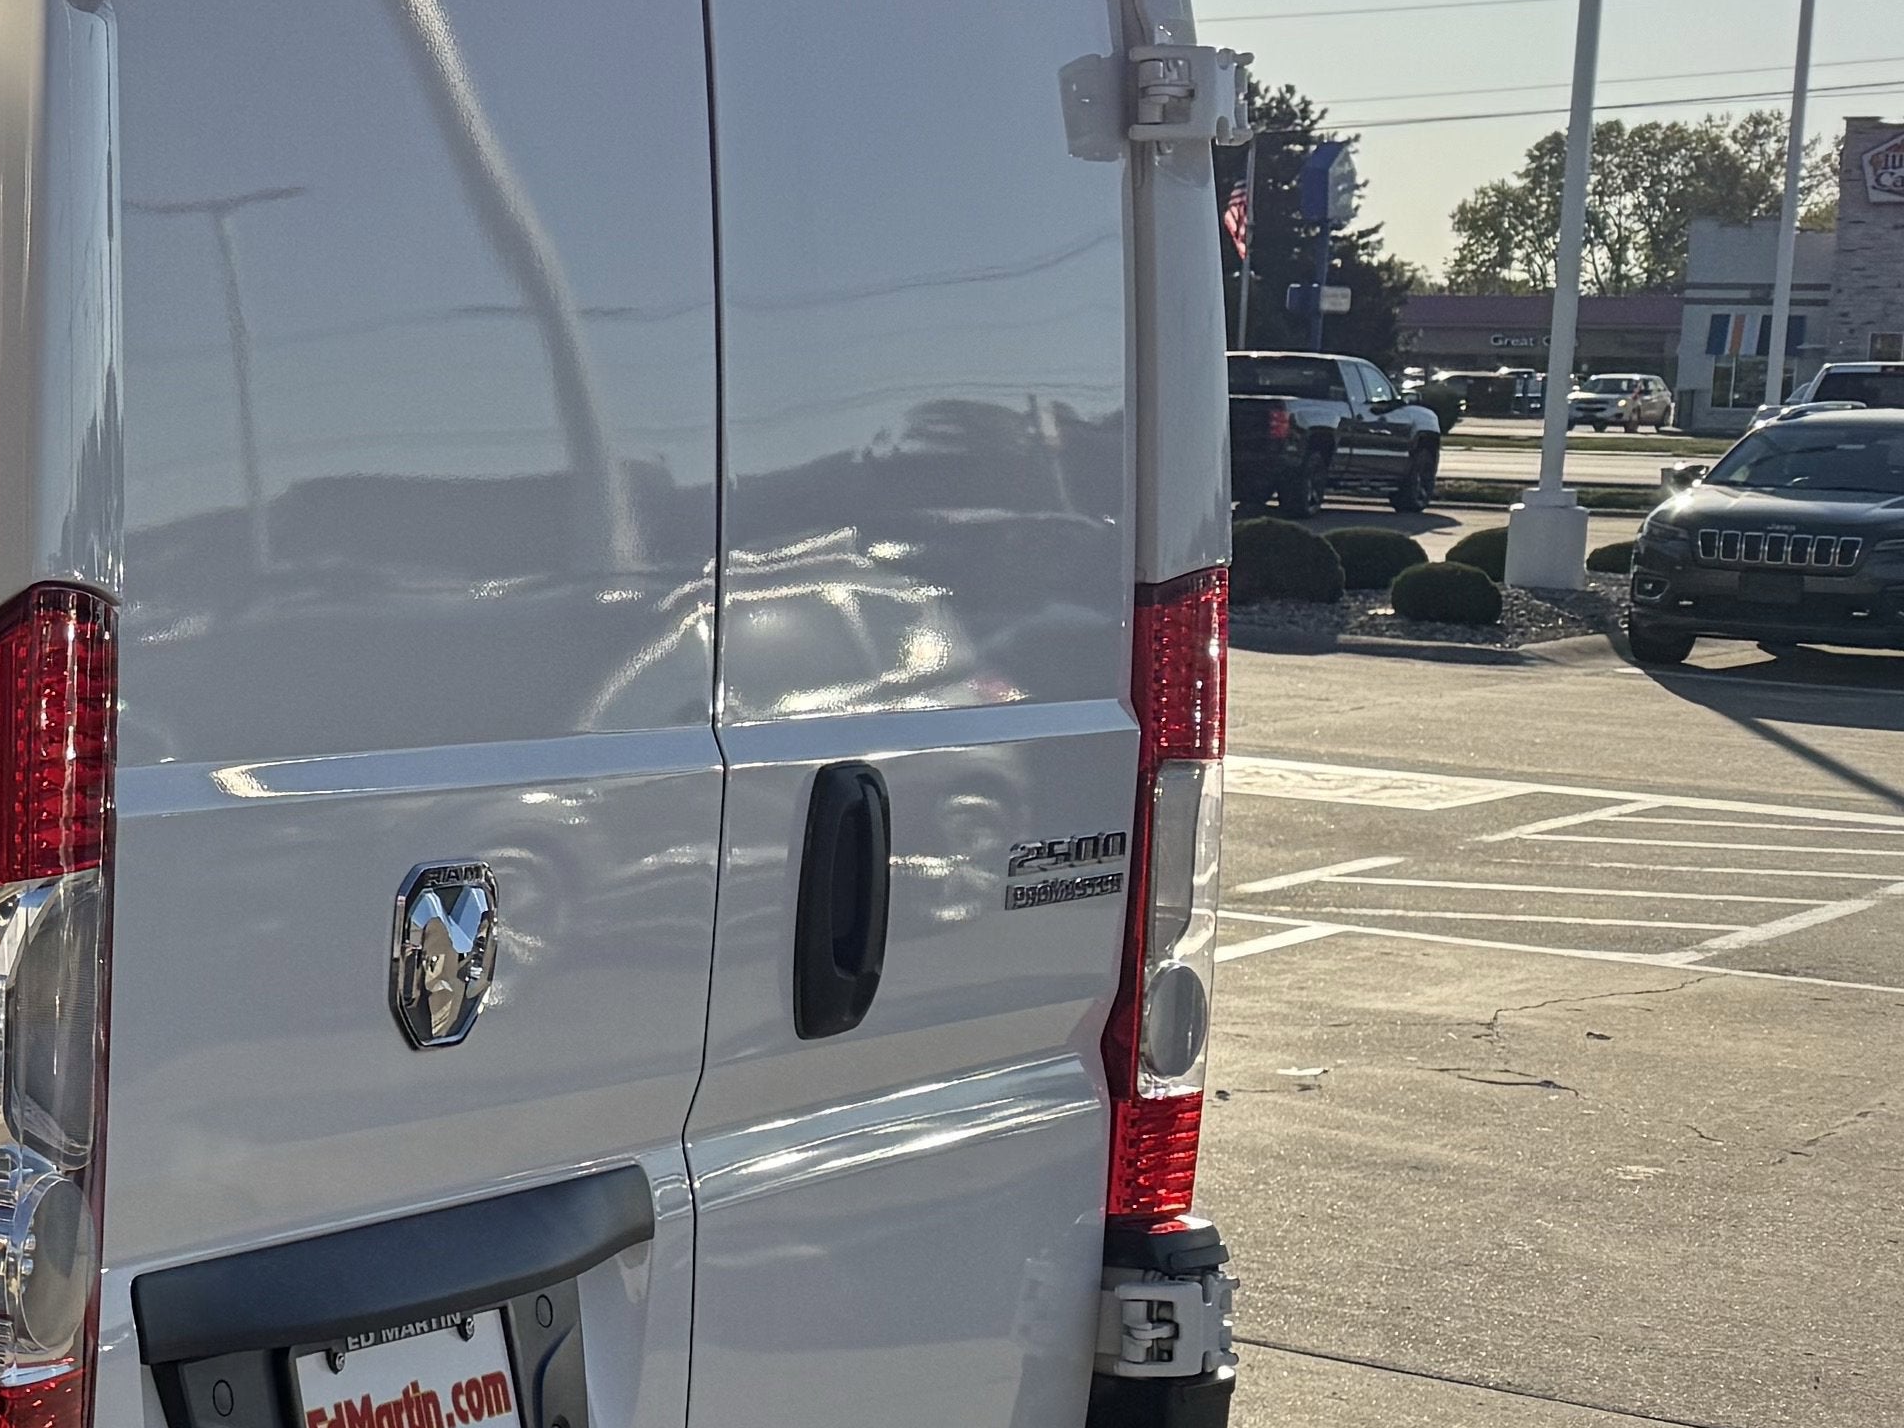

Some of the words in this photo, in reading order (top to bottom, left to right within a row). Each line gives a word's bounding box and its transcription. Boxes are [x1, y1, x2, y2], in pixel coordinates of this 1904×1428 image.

[1491, 334, 1535, 347] Great
[1008, 830, 1127, 877] 2500
[424, 866, 485, 886] RAM
[1005, 873, 1124, 910] PROMASTER
